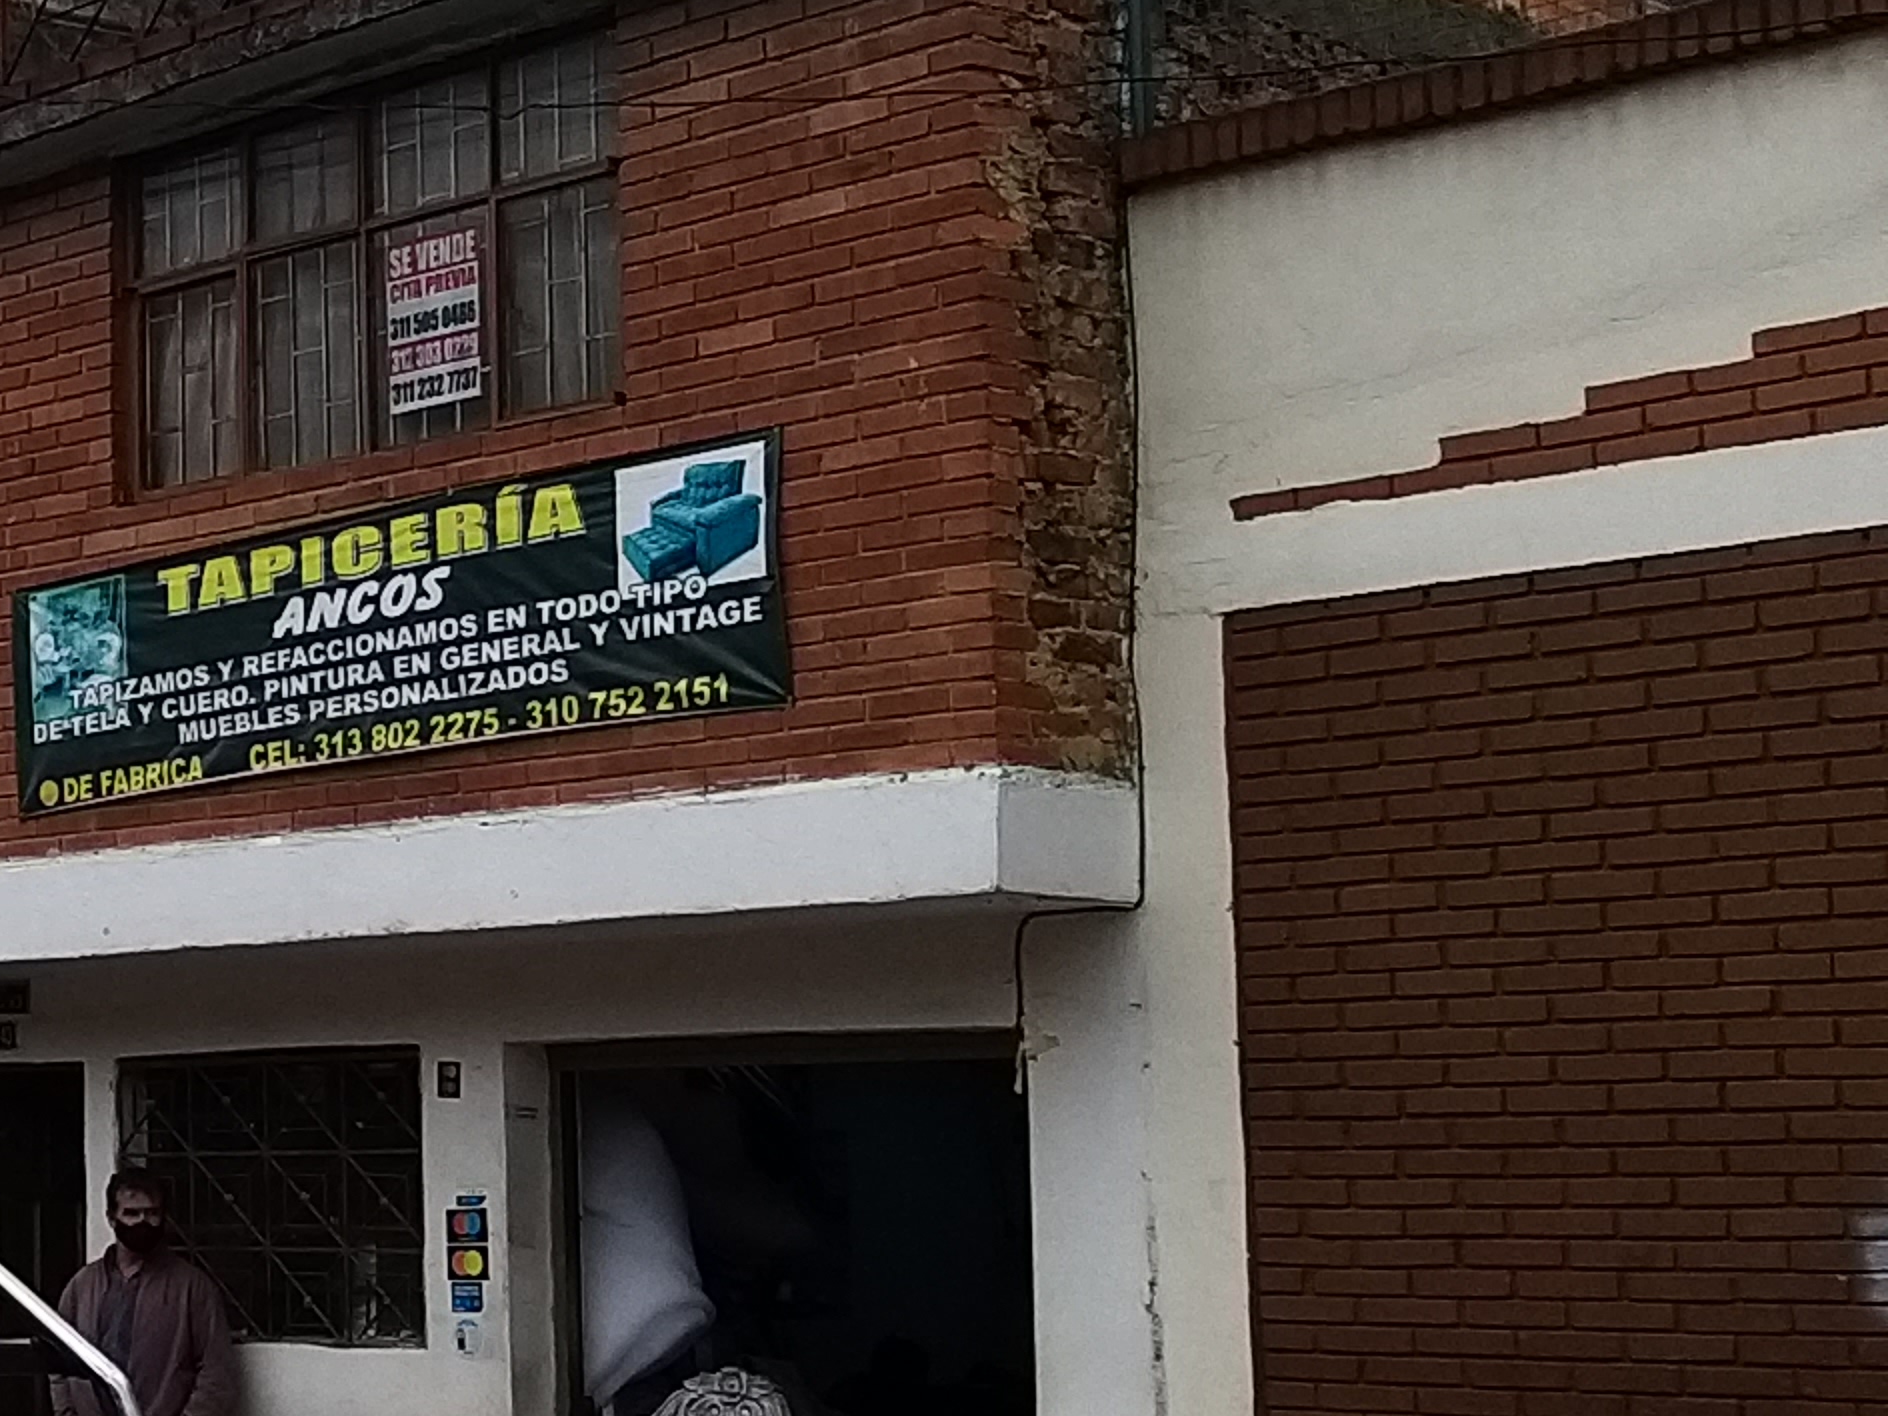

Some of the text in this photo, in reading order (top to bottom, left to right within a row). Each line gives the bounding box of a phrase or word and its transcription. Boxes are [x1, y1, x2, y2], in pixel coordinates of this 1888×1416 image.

[389, 229, 476, 278] SE VENDE
[390, 315, 411, 340] 311
[392, 380, 414, 406] 311
[157, 484, 586, 617] TAPICERÍA
[272, 565, 451, 638] ANCOS
[34, 596, 763, 744] DE TELA Y CUERO. PINTURA EN GENERAL Y VINTAGE
[70, 575, 708, 709] TAPIZAMOS Y REFACCIONAMOS EN TODO TIPO
[178, 659, 569, 744] MUEBLES PERSONALIZADOS
[249, 738, 306, 771] CEL:
[313, 727, 362, 762] 313
[371, 719, 421, 752] 802
[429, 707, 499, 745] 2275
[526, 694, 579, 730] 310
[588, 684, 646, 720] 752
[653, 672, 729, 711] 2151
[63, 755, 203, 803] DE FABRICA
